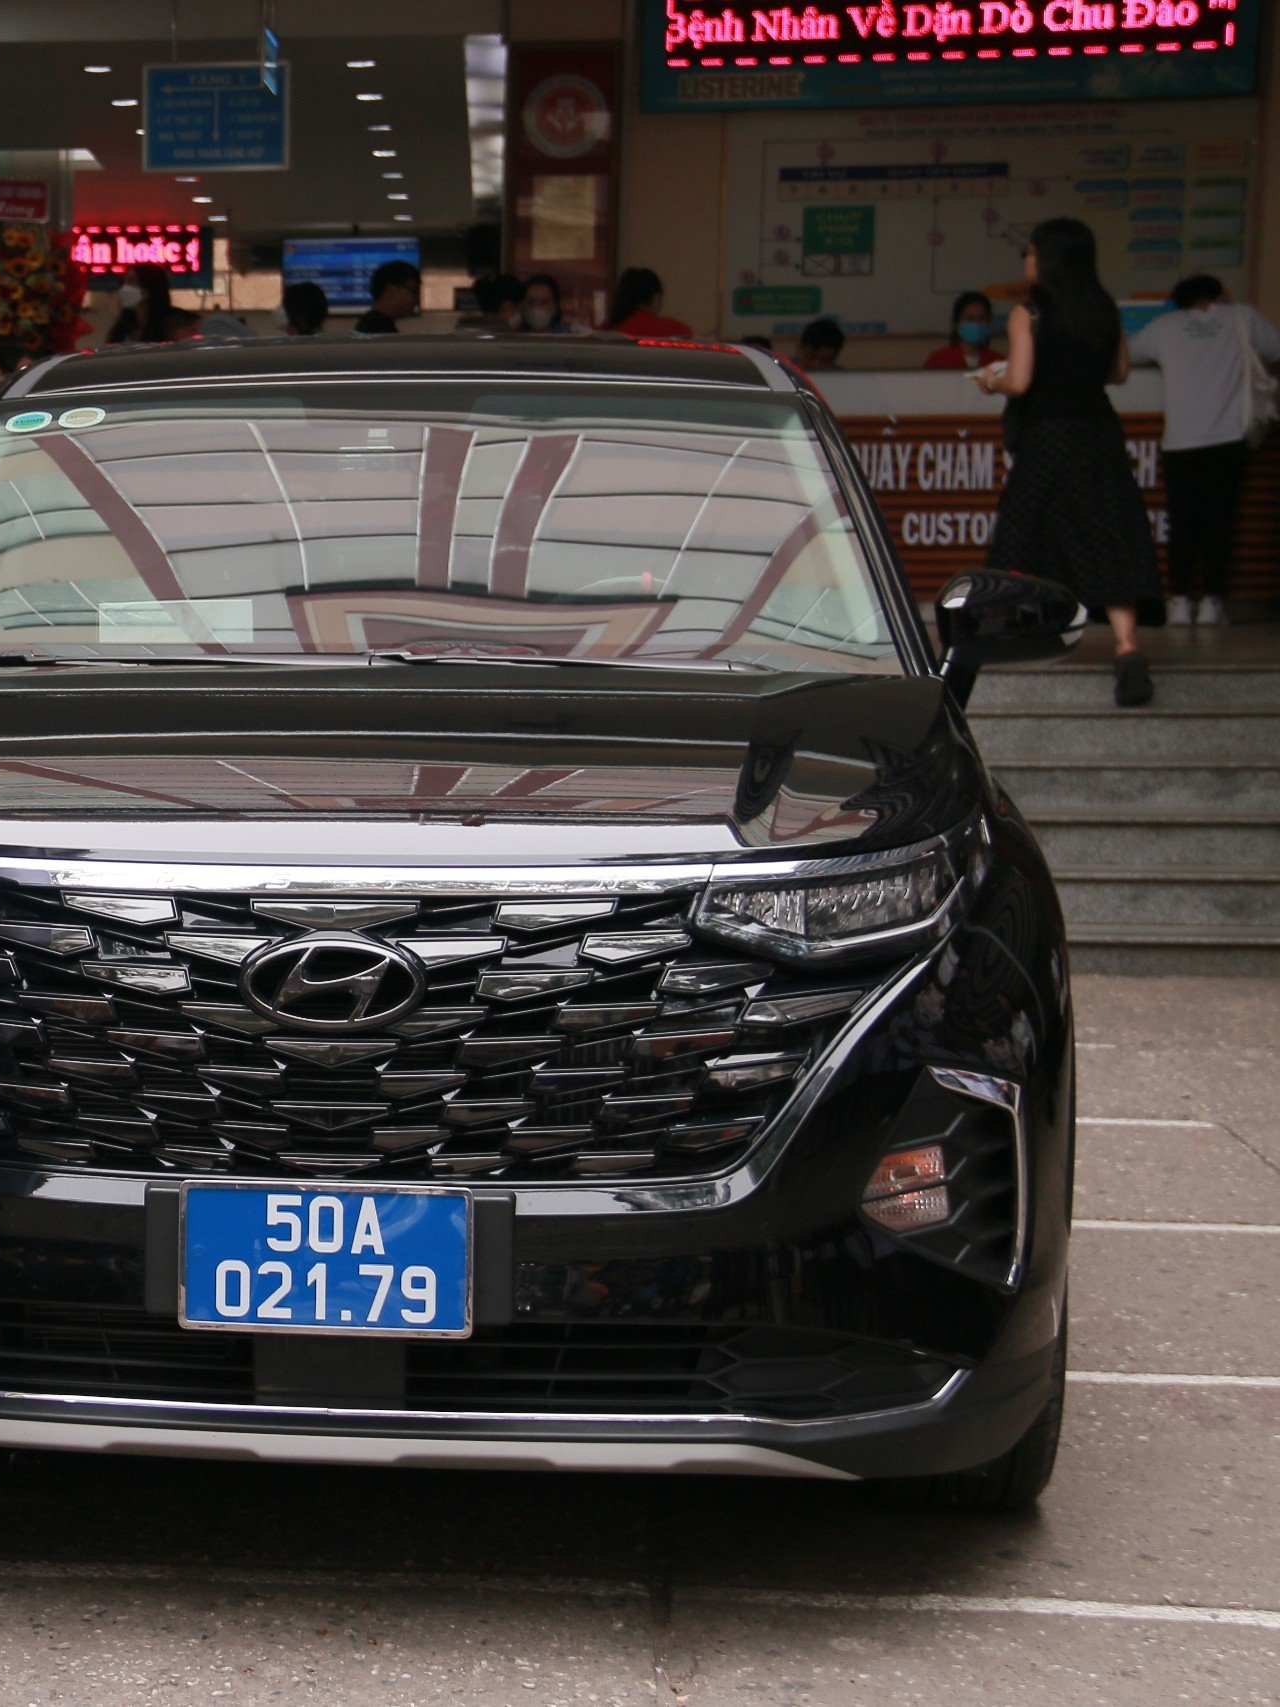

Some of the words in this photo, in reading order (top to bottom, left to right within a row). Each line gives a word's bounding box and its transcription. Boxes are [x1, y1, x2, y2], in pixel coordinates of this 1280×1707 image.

[751, 7, 839, 42] Nhân
[846, 0, 897, 38] Về
[1043, 1, 1116, 32] Chu
[679, 73, 802, 100] LISTERINE
[917, 428, 994, 491] CHĂM
[266, 1194, 386, 1255] 50A
[215, 1259, 437, 1324] 021.79
